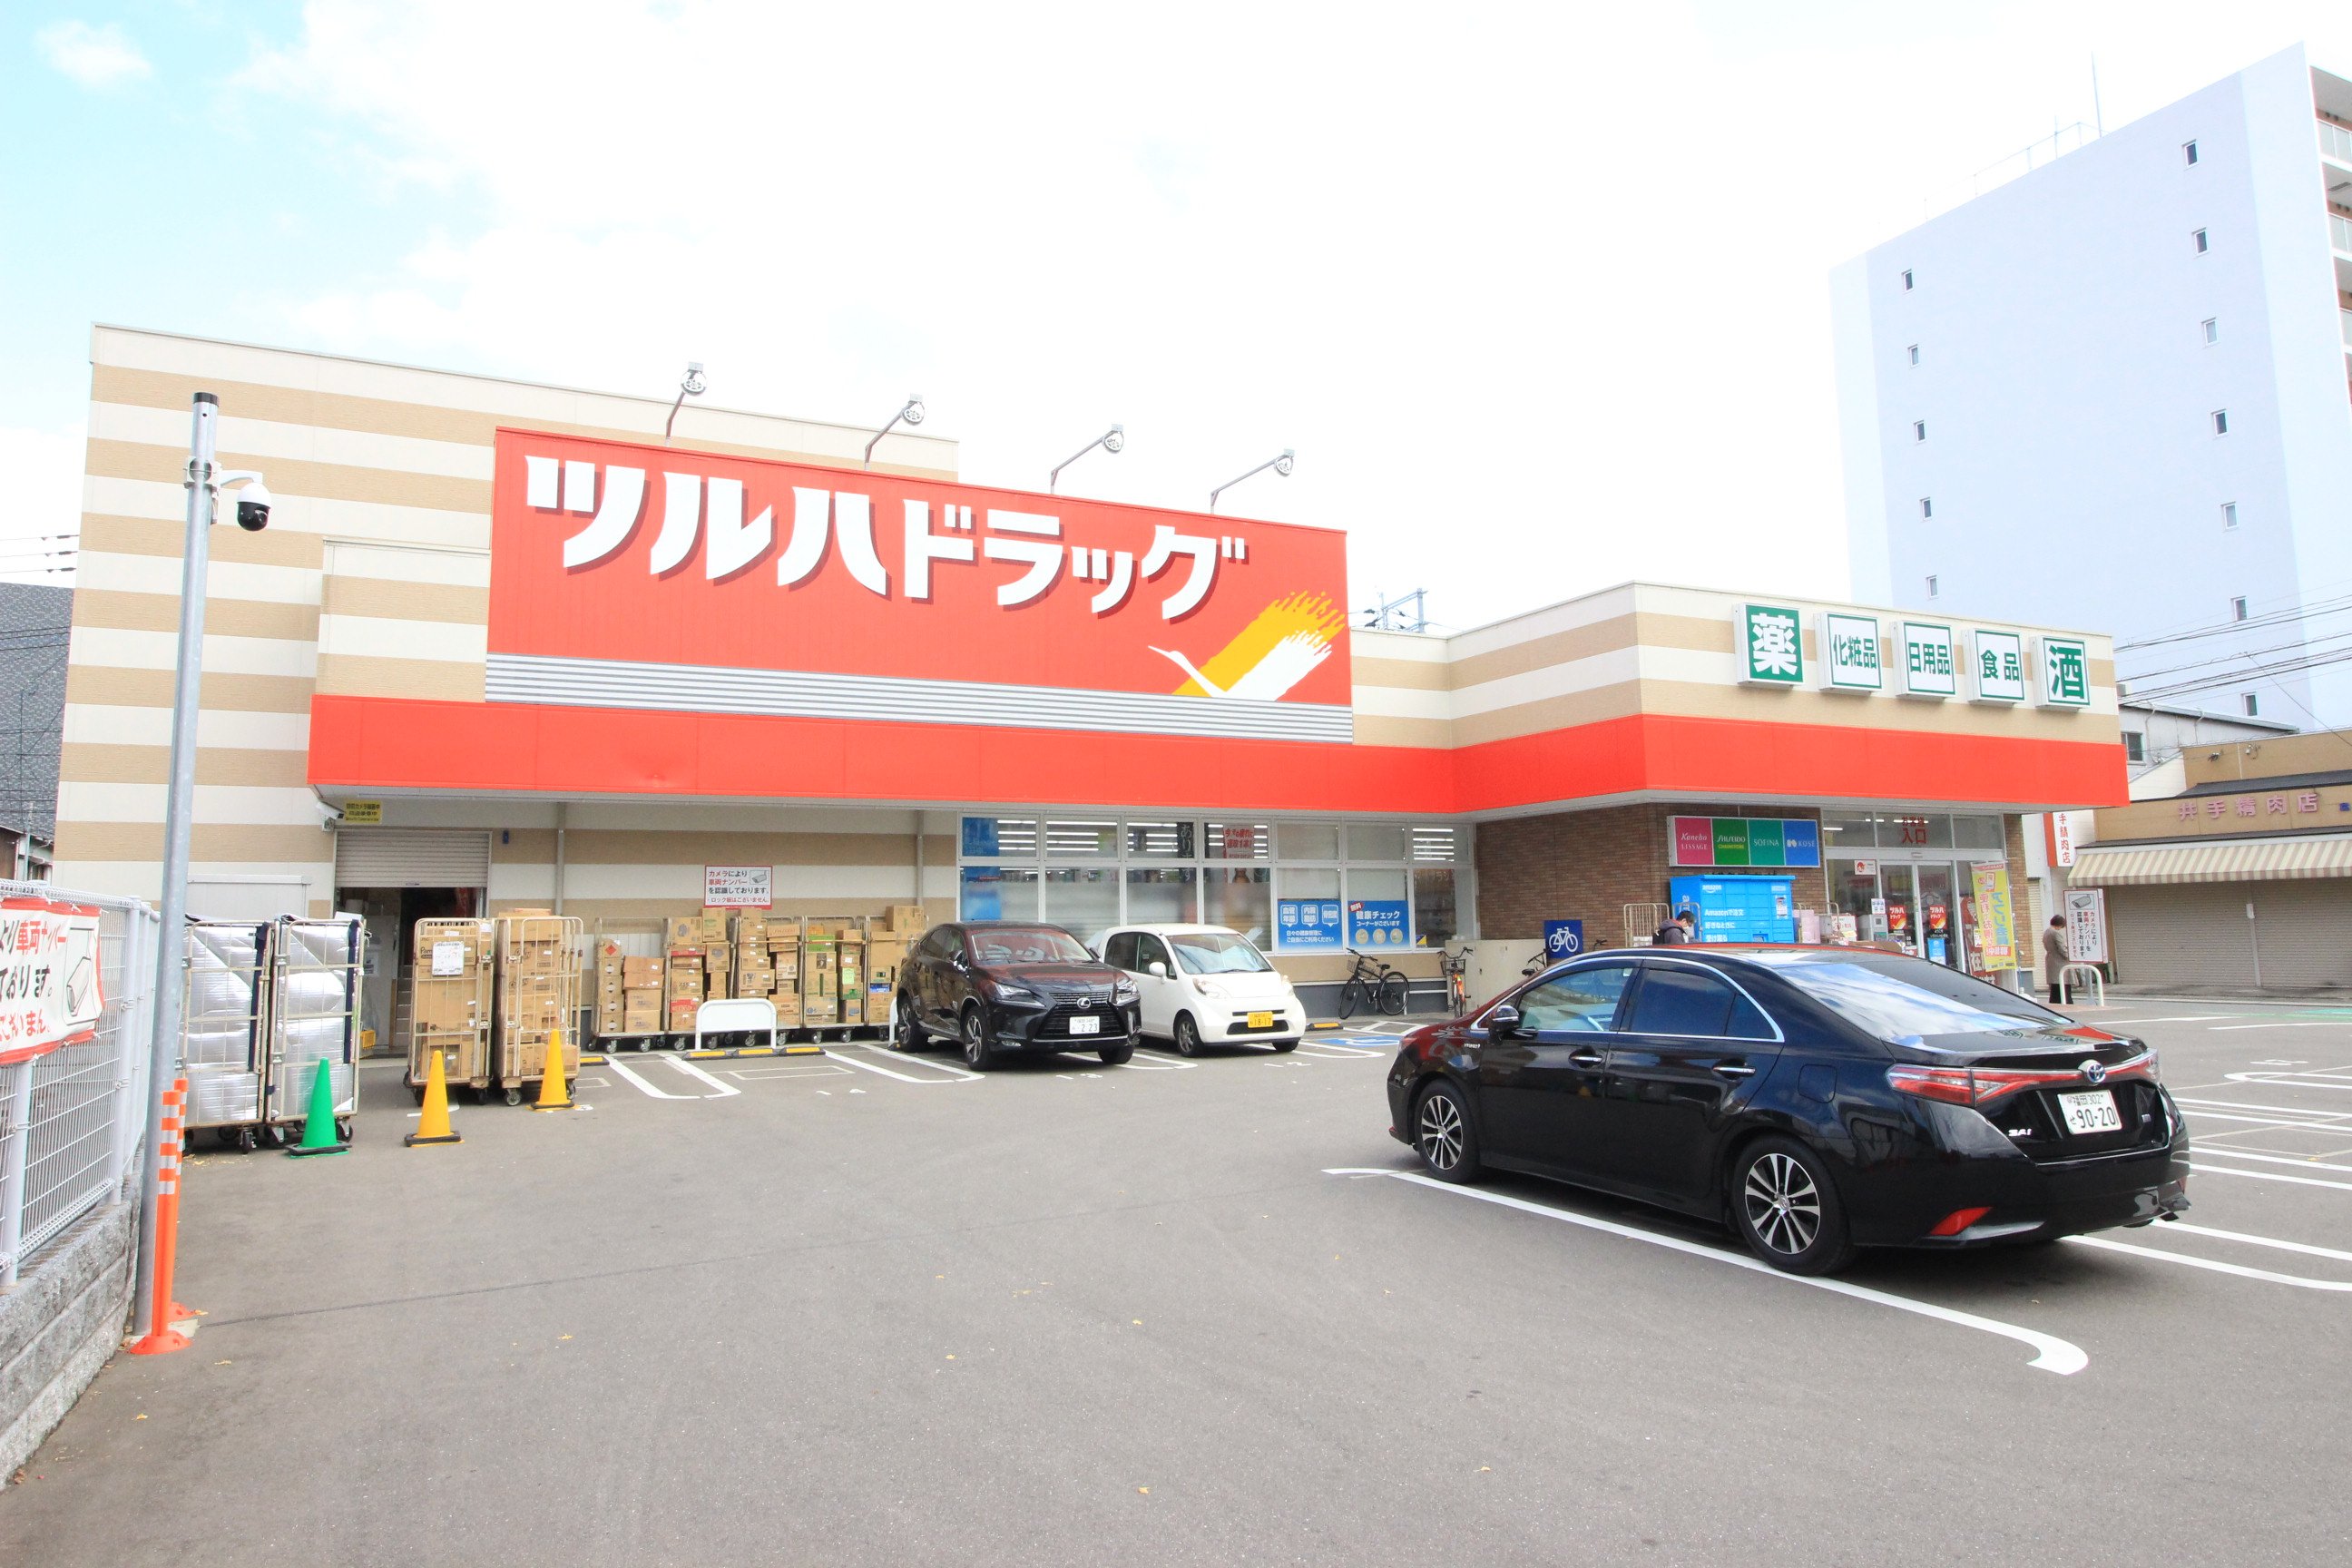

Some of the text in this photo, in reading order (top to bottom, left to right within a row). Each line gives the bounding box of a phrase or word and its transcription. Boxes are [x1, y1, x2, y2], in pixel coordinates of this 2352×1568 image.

[525, 455, 1249, 621] ツルハドラッグ
[1751, 613, 1798, 675] 薬
[1833, 634, 1877, 669] 化粧品
[1908, 642, 1950, 675] 日用品
[1981, 650, 2020, 681] 食品
[2049, 645, 2085, 699] 酒
[2179, 792, 2319, 821] 井手精肉店
[1681, 832, 1707, 841] Kanebo
[1717, 835, 1746, 843] SHISEIDO
[1753, 838, 1779, 847] SOFINA
[1902, 828, 1926, 844] 入口
[1356, 910, 1400, 920] 健康チェック
[2083, 911, 2092, 952] 車両ナンバーを
[1254, 1017, 1271, 1026] 18-17
[2073, 1093, 2102, 1106] 福岡 302
[2076, 1106, 2116, 1128] 90-20
